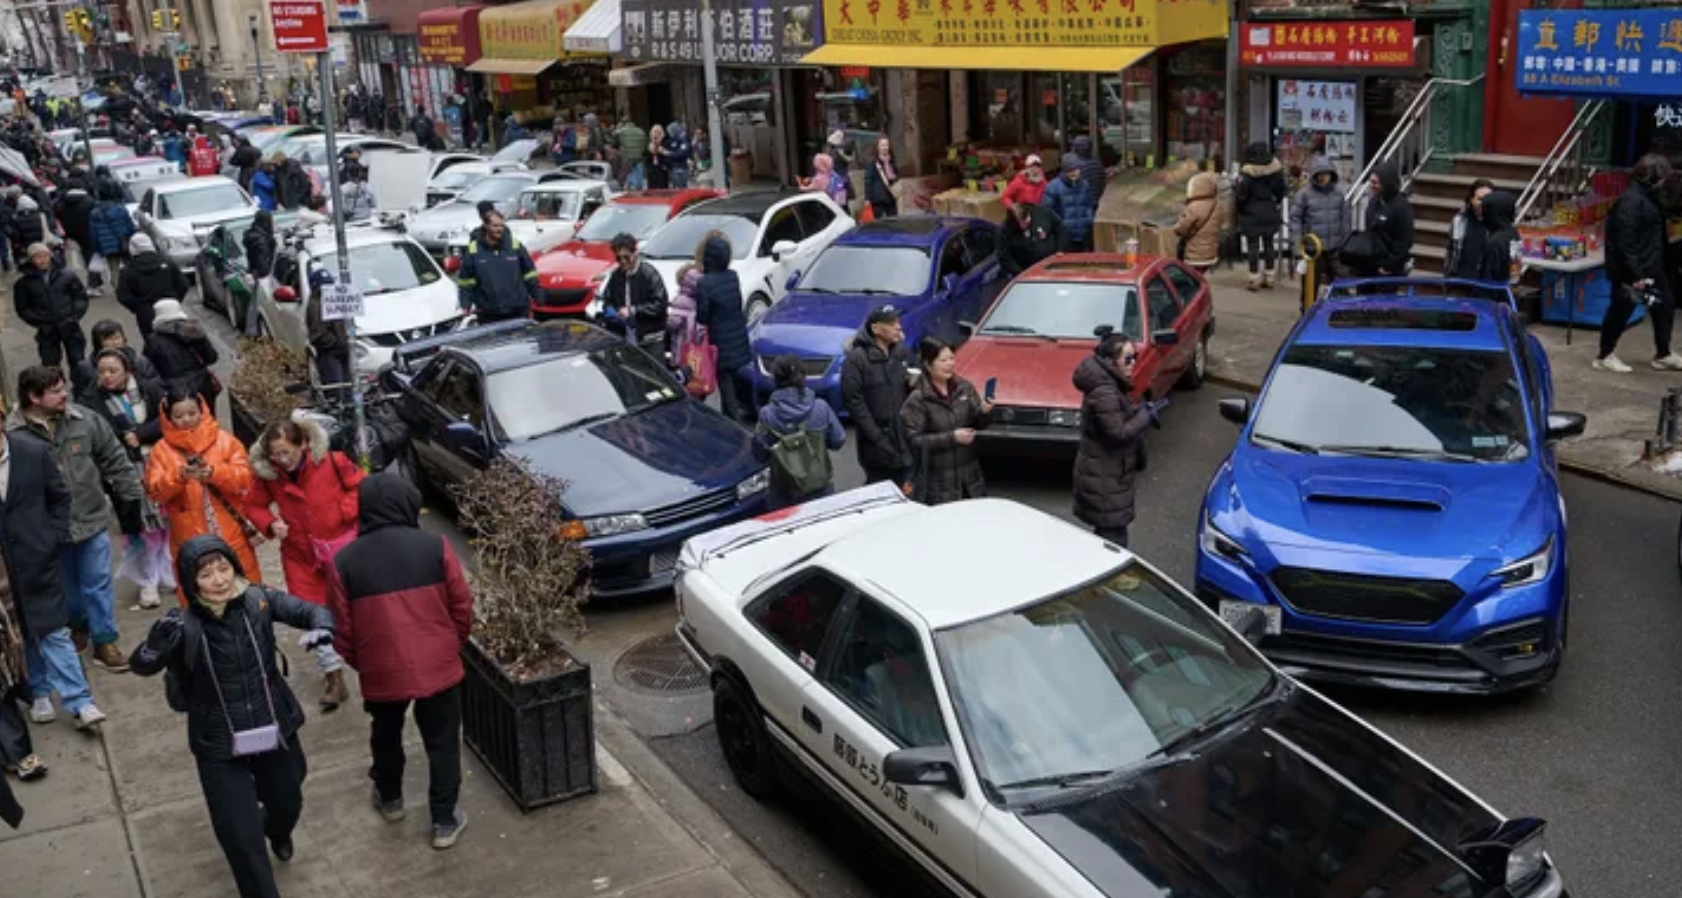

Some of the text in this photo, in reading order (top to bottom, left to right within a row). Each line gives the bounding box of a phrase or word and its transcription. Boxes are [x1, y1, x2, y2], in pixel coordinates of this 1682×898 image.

[651, 8, 774, 41] 新伊利伯酒莊
